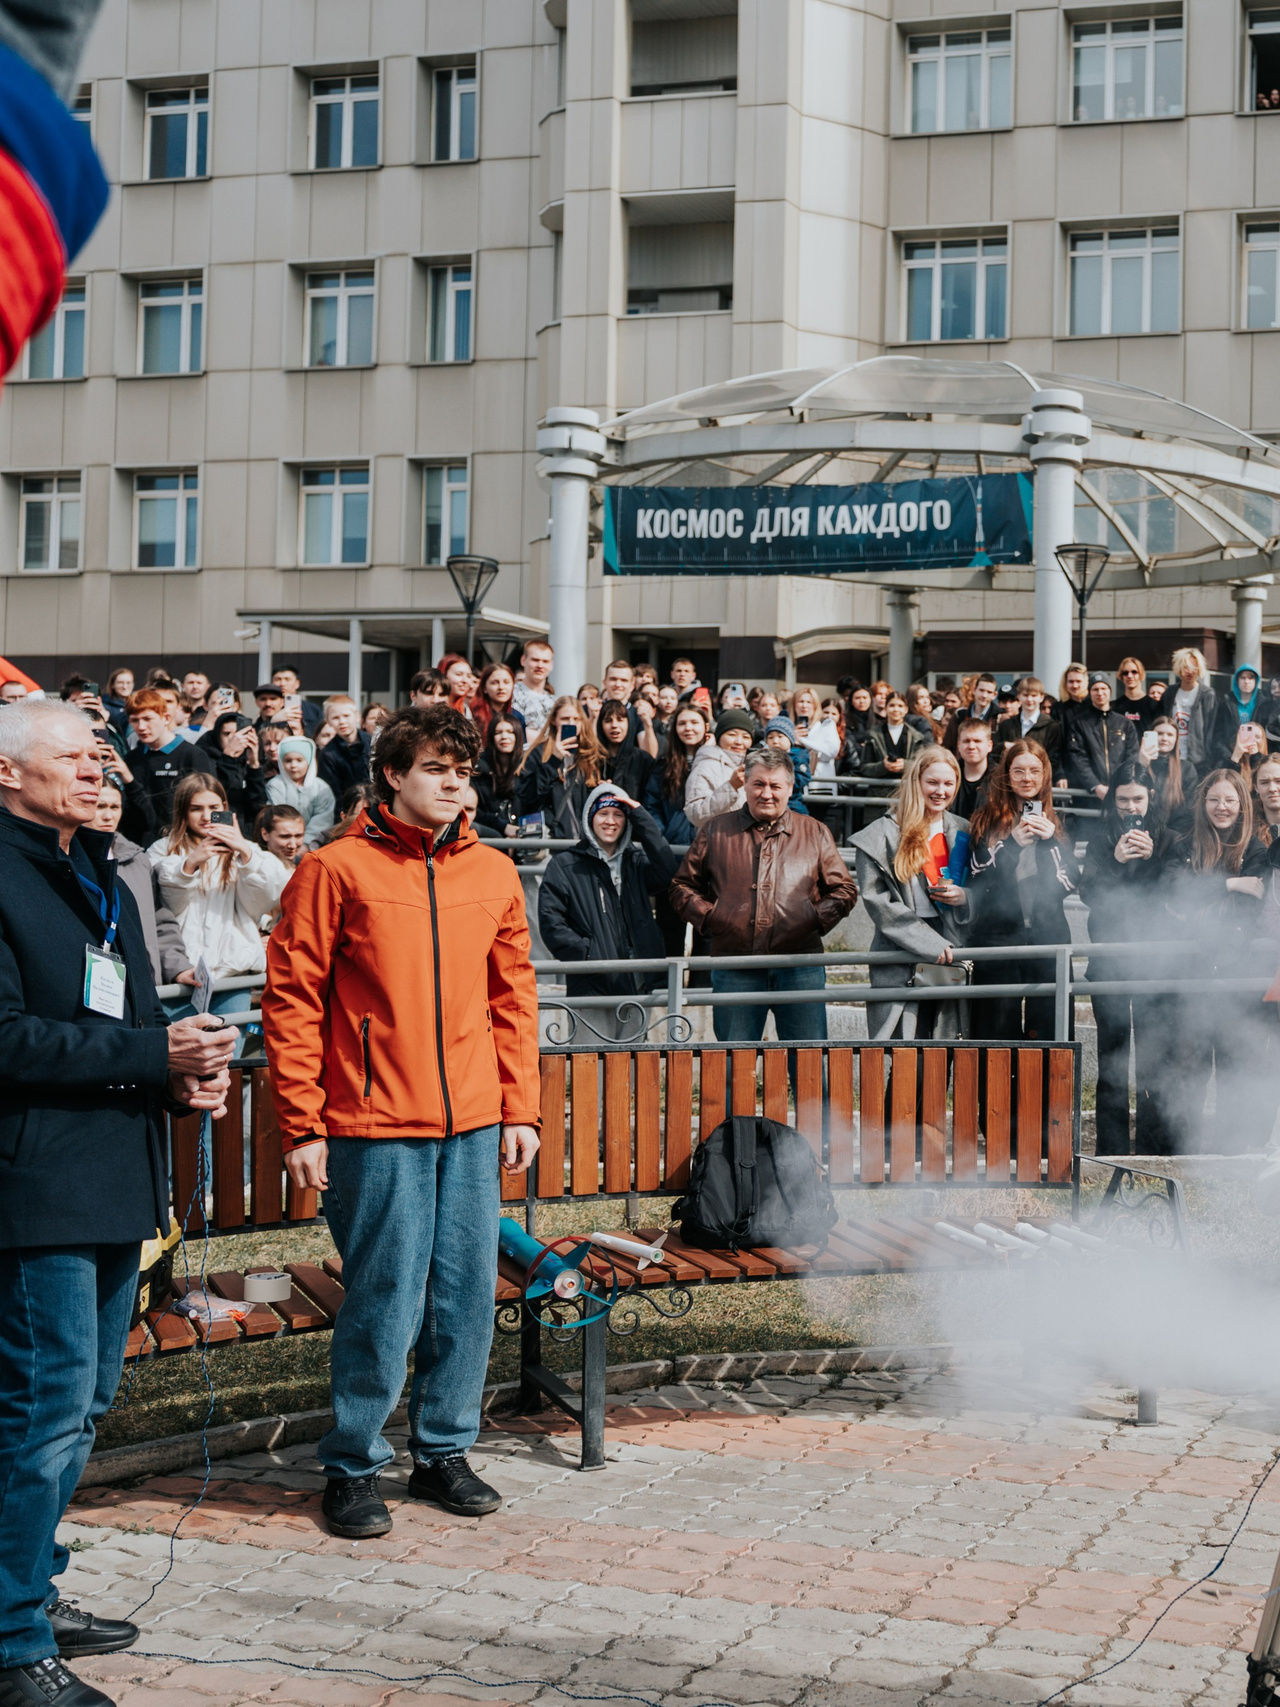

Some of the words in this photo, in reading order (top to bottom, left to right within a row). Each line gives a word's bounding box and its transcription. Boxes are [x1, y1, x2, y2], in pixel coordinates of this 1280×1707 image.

[636, 508, 744, 539] КОСМОС
[751, 507, 810, 543] ДЛЯ
[817, 500, 951, 539] КАЖДОГО
